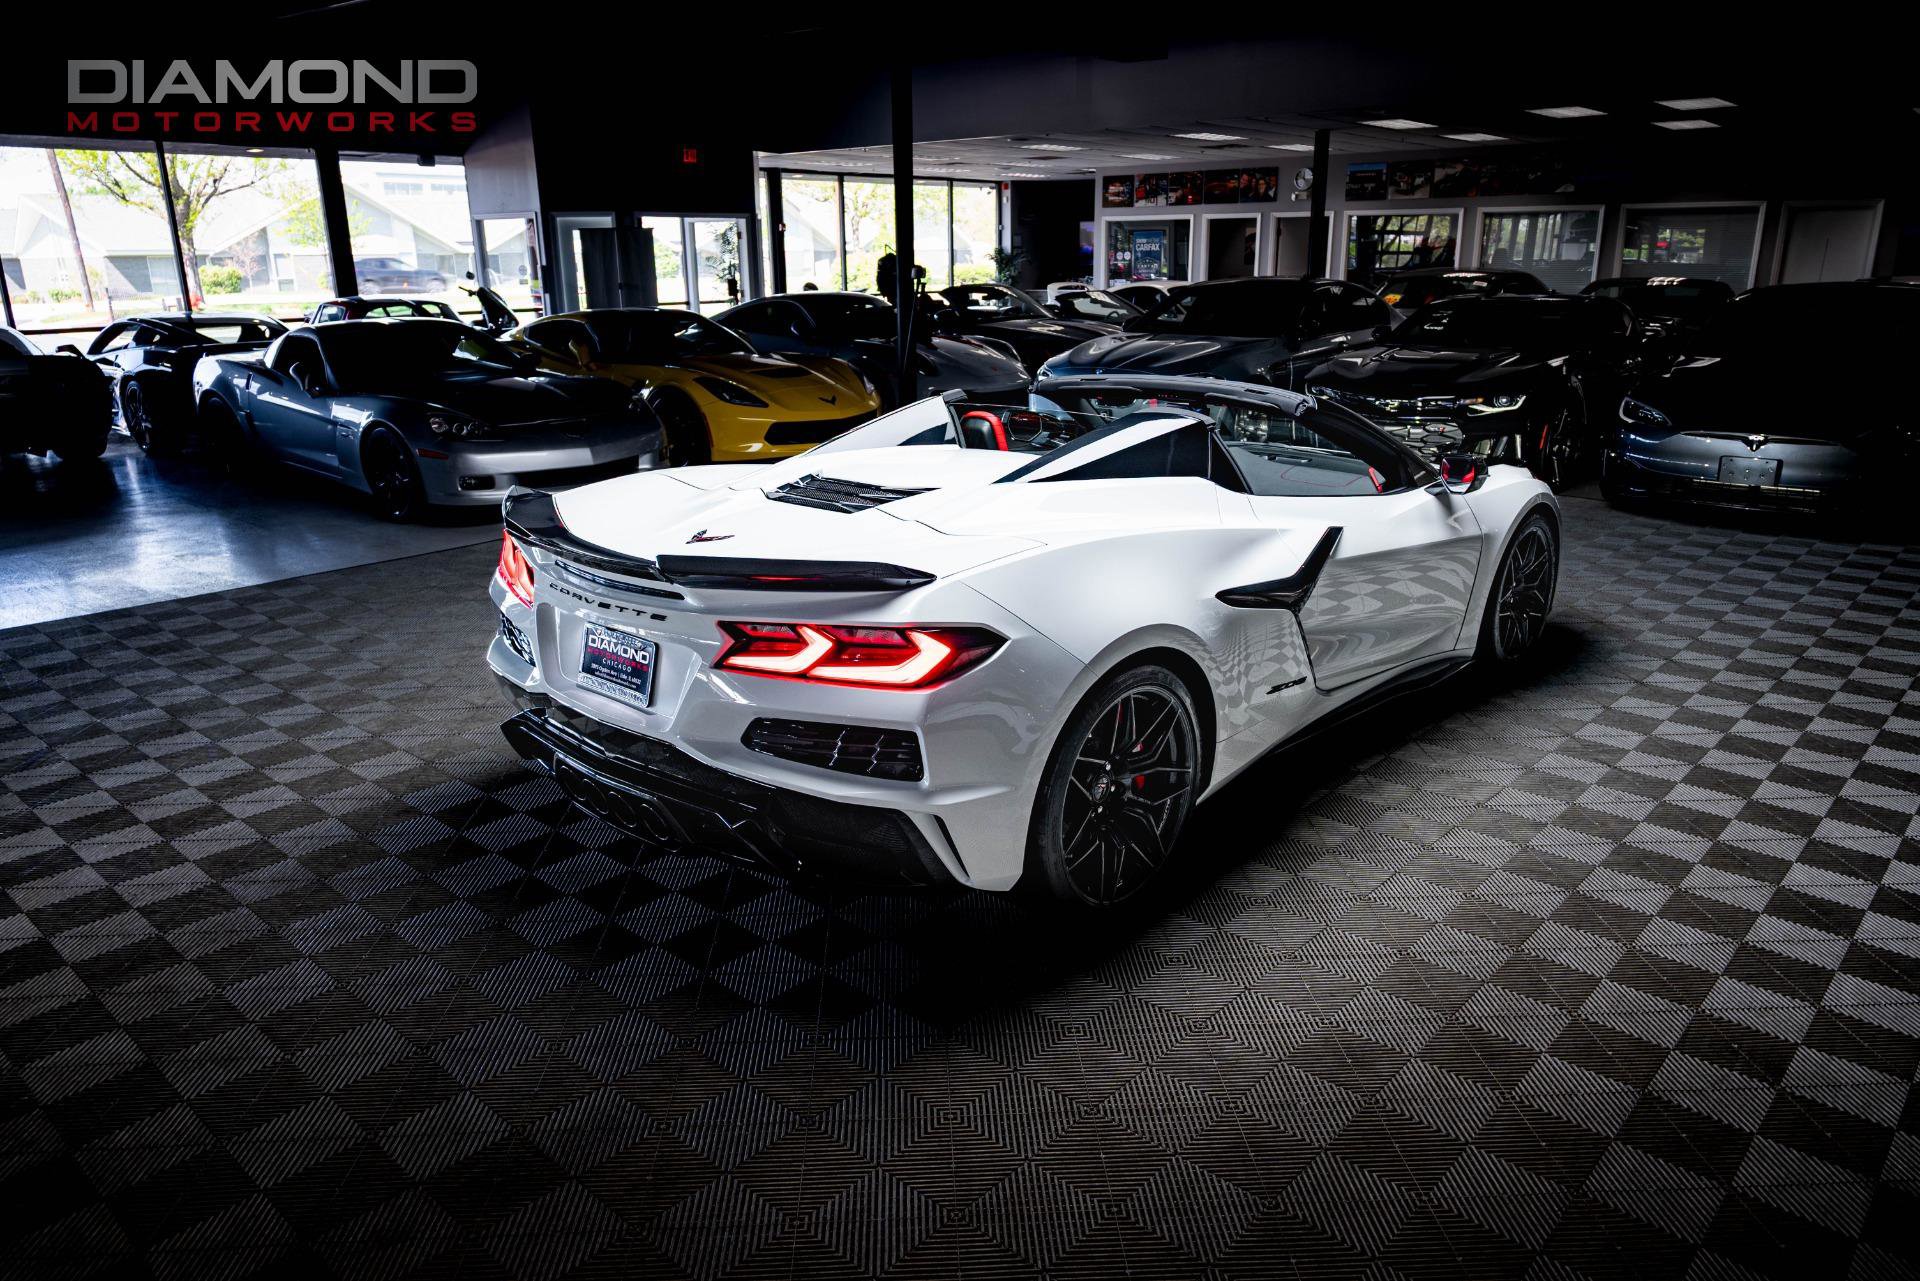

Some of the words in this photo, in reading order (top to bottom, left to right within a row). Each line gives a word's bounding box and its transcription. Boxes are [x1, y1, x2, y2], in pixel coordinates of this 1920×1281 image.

[1135, 243, 1160, 251] CARFAX
[549, 582, 668, 621] CORVETTE
[588, 634, 650, 664] DIAMOND
[602, 658, 632, 672] CHICAGO
